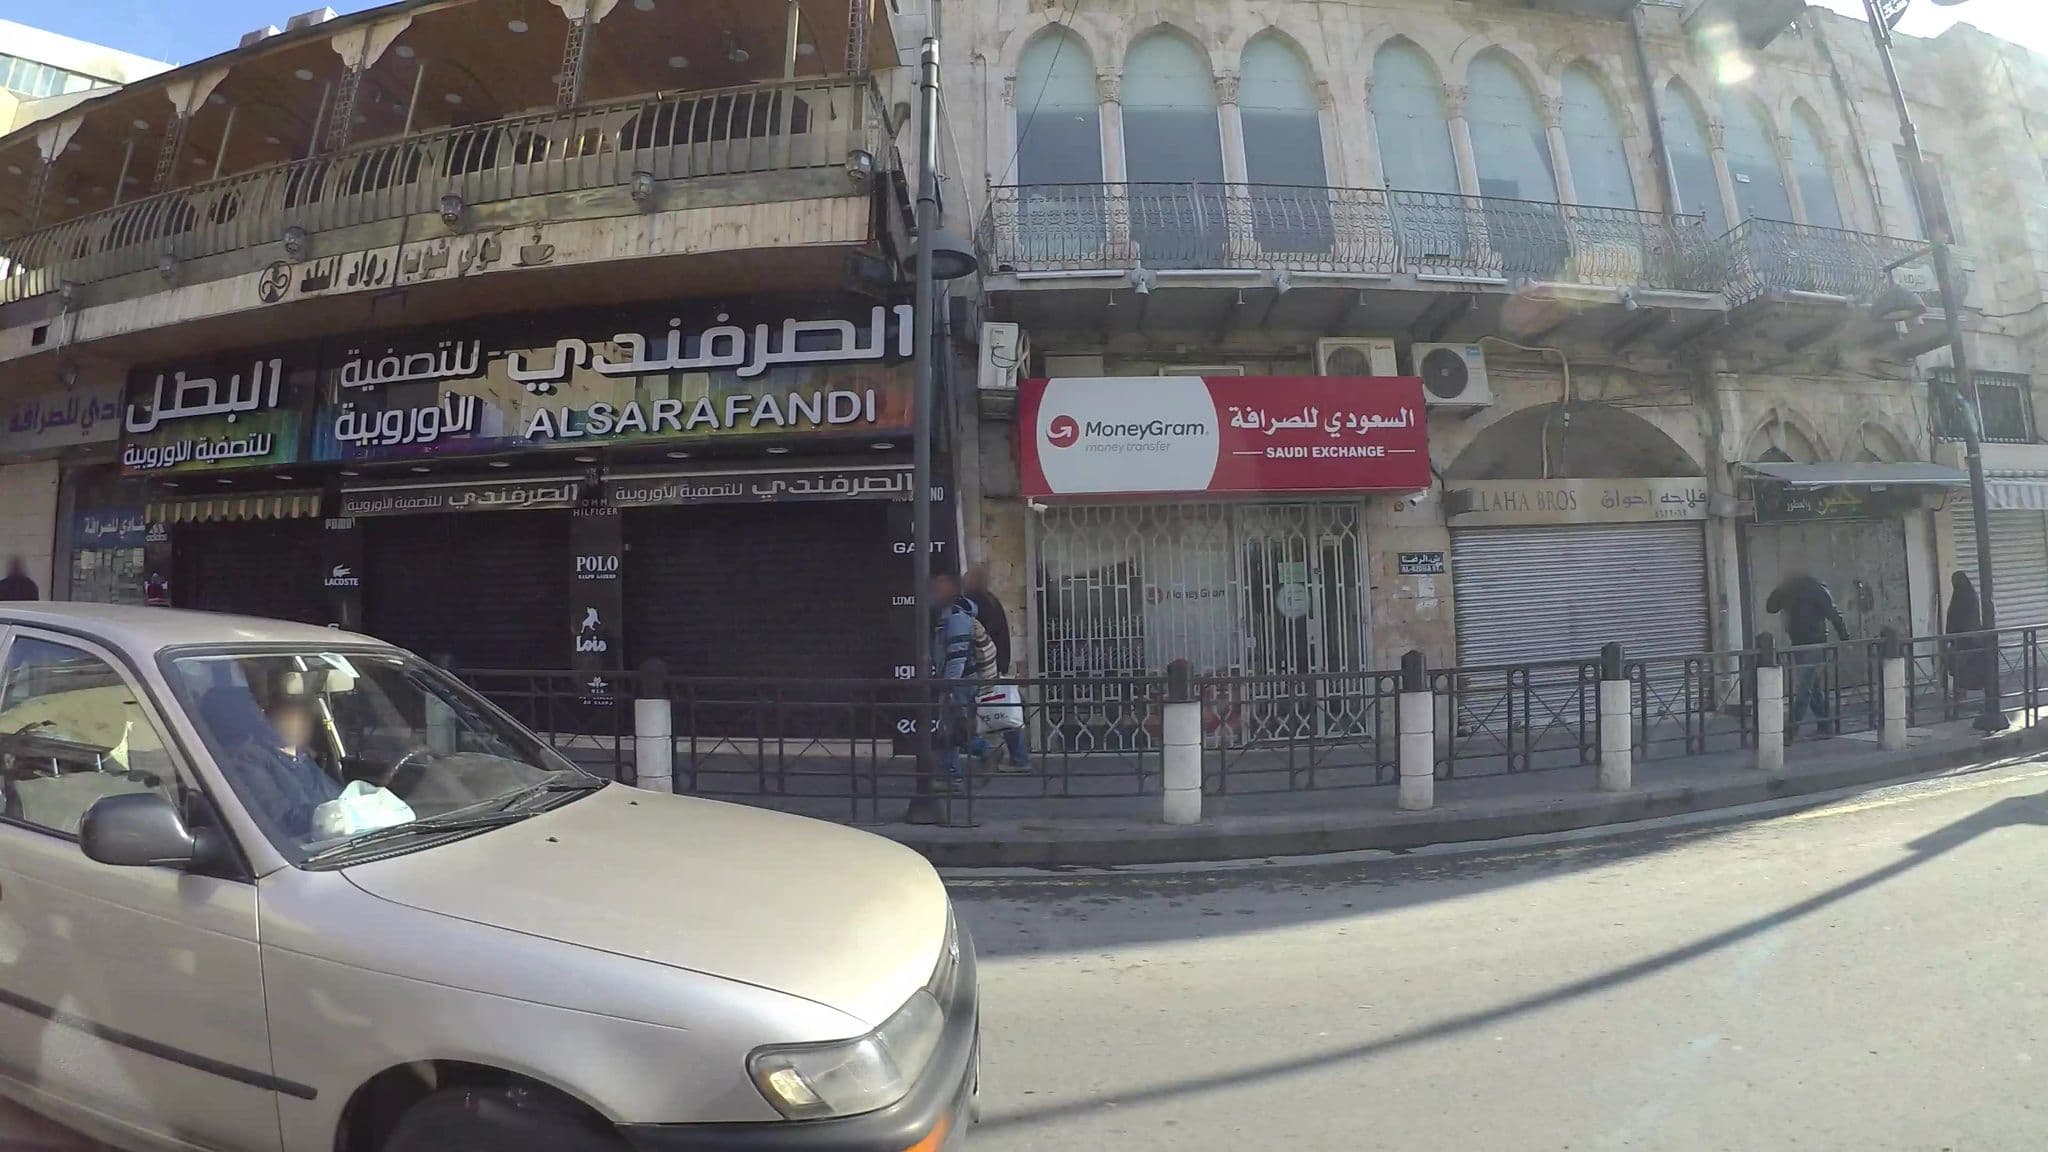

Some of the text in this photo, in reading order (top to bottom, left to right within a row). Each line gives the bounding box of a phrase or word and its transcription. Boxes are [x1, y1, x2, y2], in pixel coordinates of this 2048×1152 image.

[347, 249, 388, 288] رواد
[506, 304, 914, 393] الصرفندي
[340, 339, 481, 392] للتصفية
[125, 358, 283, 433] البطل
[334, 391, 476, 447] الأوروبية
[524, 388, 876, 441] ALSARAFANDI
[1228, 405, 1415, 438] السعودي للصرافة
[1085, 420, 1205, 441] MoneyGram
[195, 432, 272, 464] للتصفية
[1086, 441, 1171, 454] money transfer
[1266, 446, 1385, 458] SAUDI EXCHANGE
[449, 483, 578, 509] الصرفندي
[680, 482, 743, 501] للتصفية
[751, 472, 914, 499] الصرفندي
[395, 495, 442, 511] للتصفية
[573, 507, 618, 517] HILFIGER
[1536, 489, 1578, 512] BROS
[893, 541, 945, 554] GAT
[576, 555, 619, 572] POLO
[324, 578, 359, 587] LACOSTE
